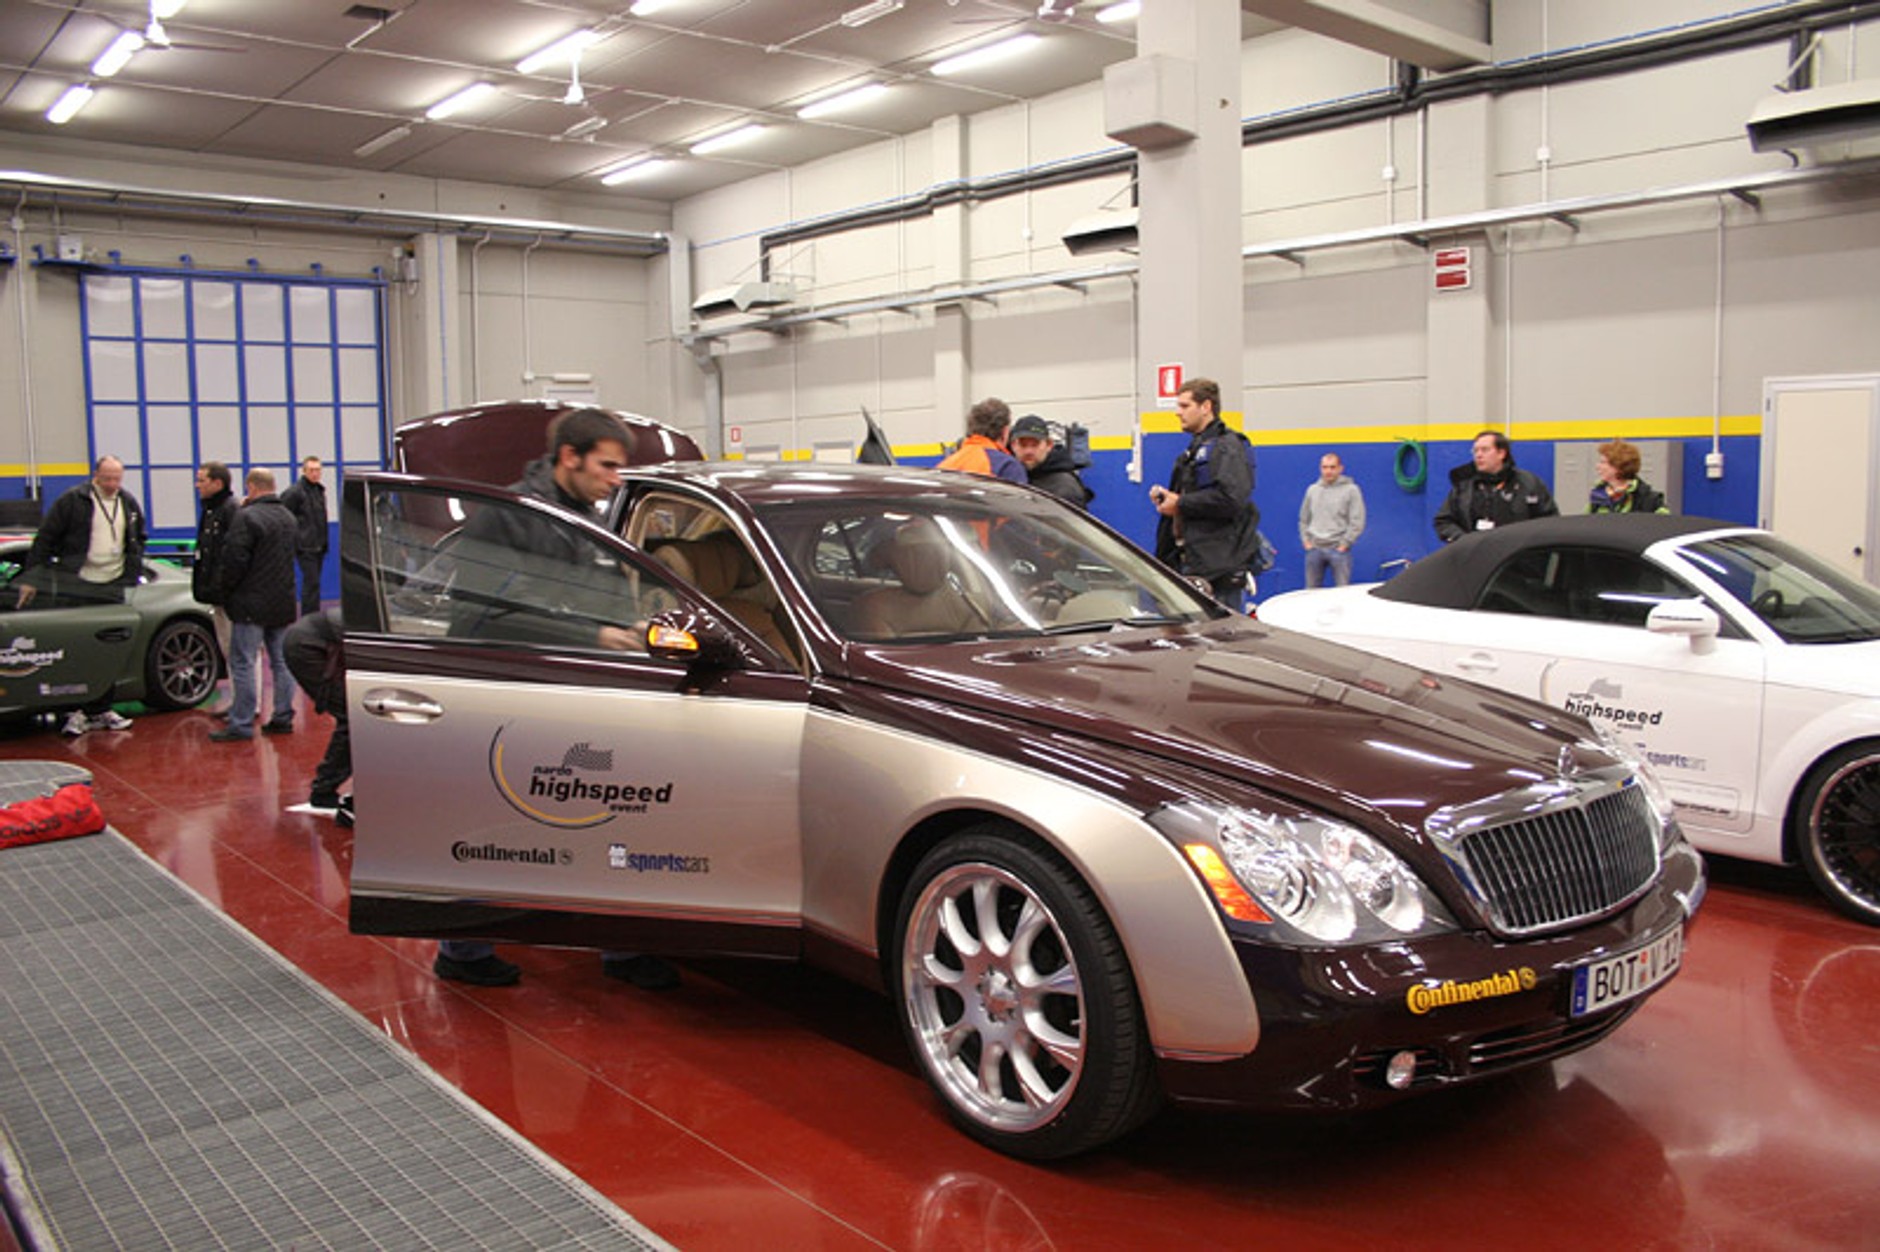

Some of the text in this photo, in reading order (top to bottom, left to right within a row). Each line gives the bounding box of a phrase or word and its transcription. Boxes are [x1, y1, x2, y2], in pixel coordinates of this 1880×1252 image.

[1565, 699, 1663, 725] highspeed
[533, 765, 573, 776] nardo
[529, 776, 673, 803] highspeed
[609, 803, 648, 814] event
[451, 841, 556, 865] Continental
[1406, 969, 1521, 1015] Continental
[1594, 956, 1639, 1003] BOT
